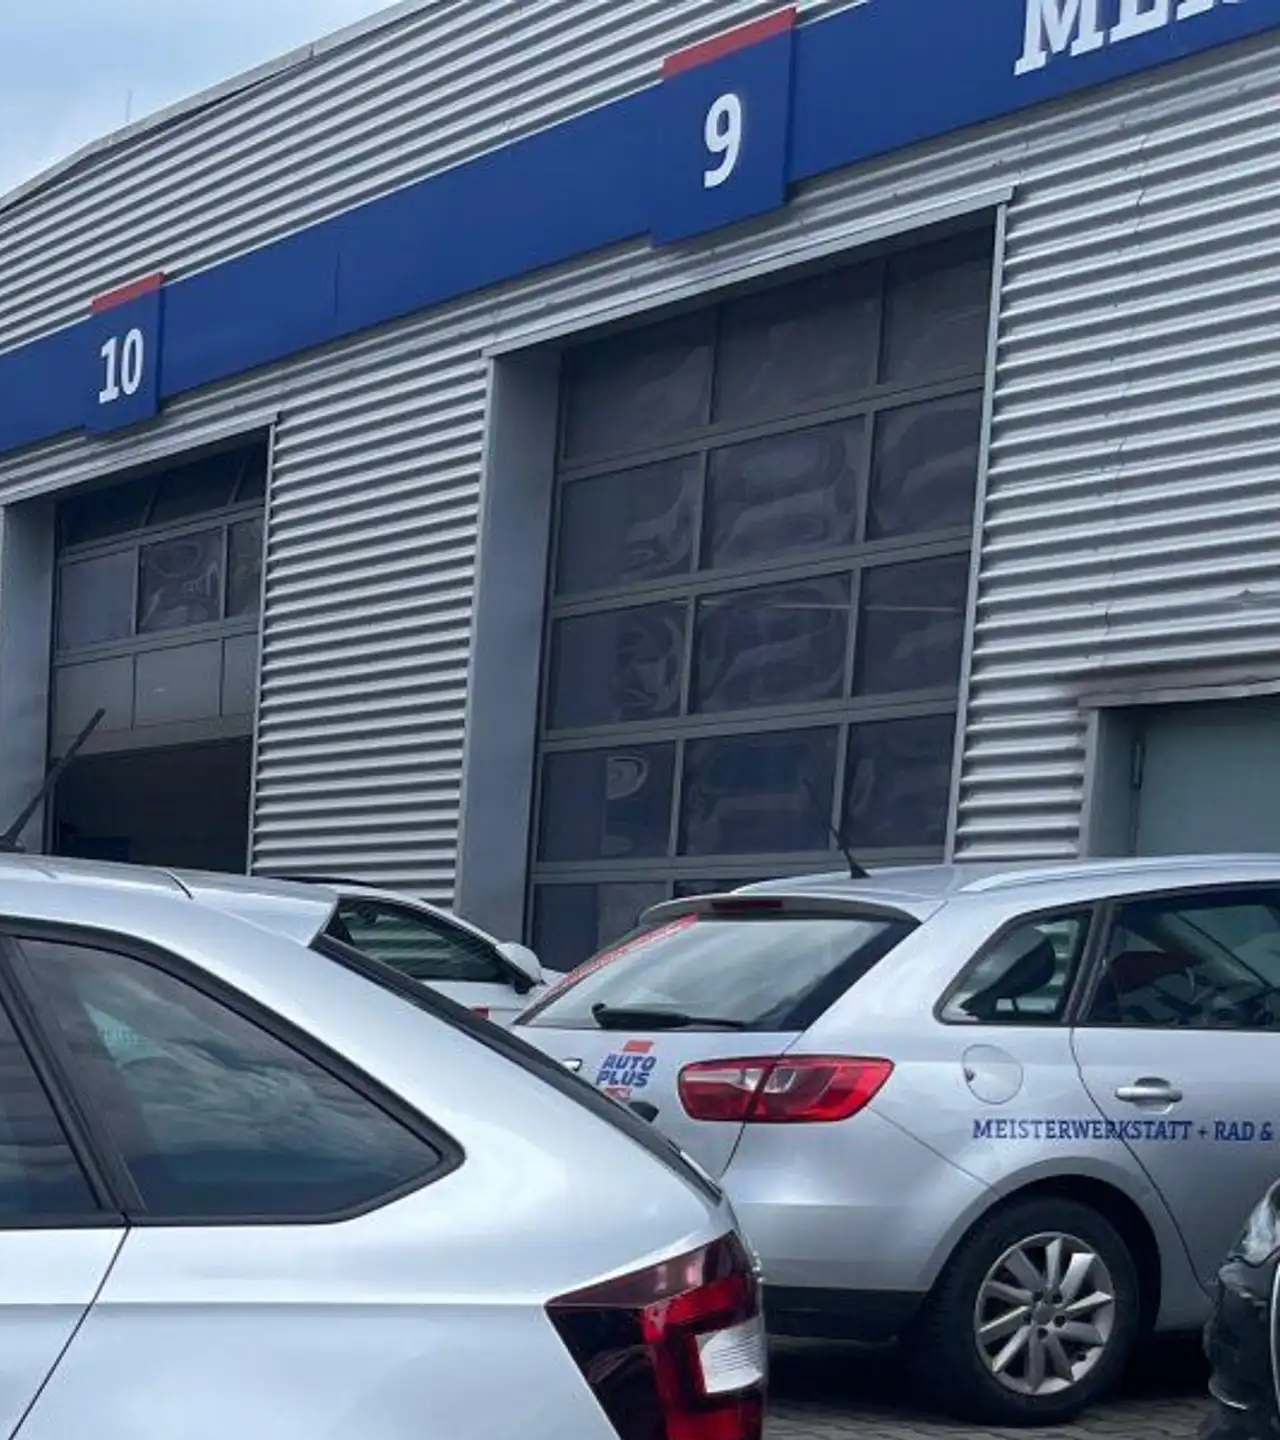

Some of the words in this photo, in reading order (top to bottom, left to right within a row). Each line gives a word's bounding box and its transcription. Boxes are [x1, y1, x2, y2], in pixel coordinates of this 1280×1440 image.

[704, 93, 742, 188] 9
[99, 328, 144, 404] 10
[601, 1053, 657, 1072] AUTO
[596, 1069, 650, 1088] PLUS
[972, 1118, 1192, 1141] MEISTERWERKSTATT
[1213, 1120, 1255, 1142] RAD
[1260, 1121, 1274, 1142] &
